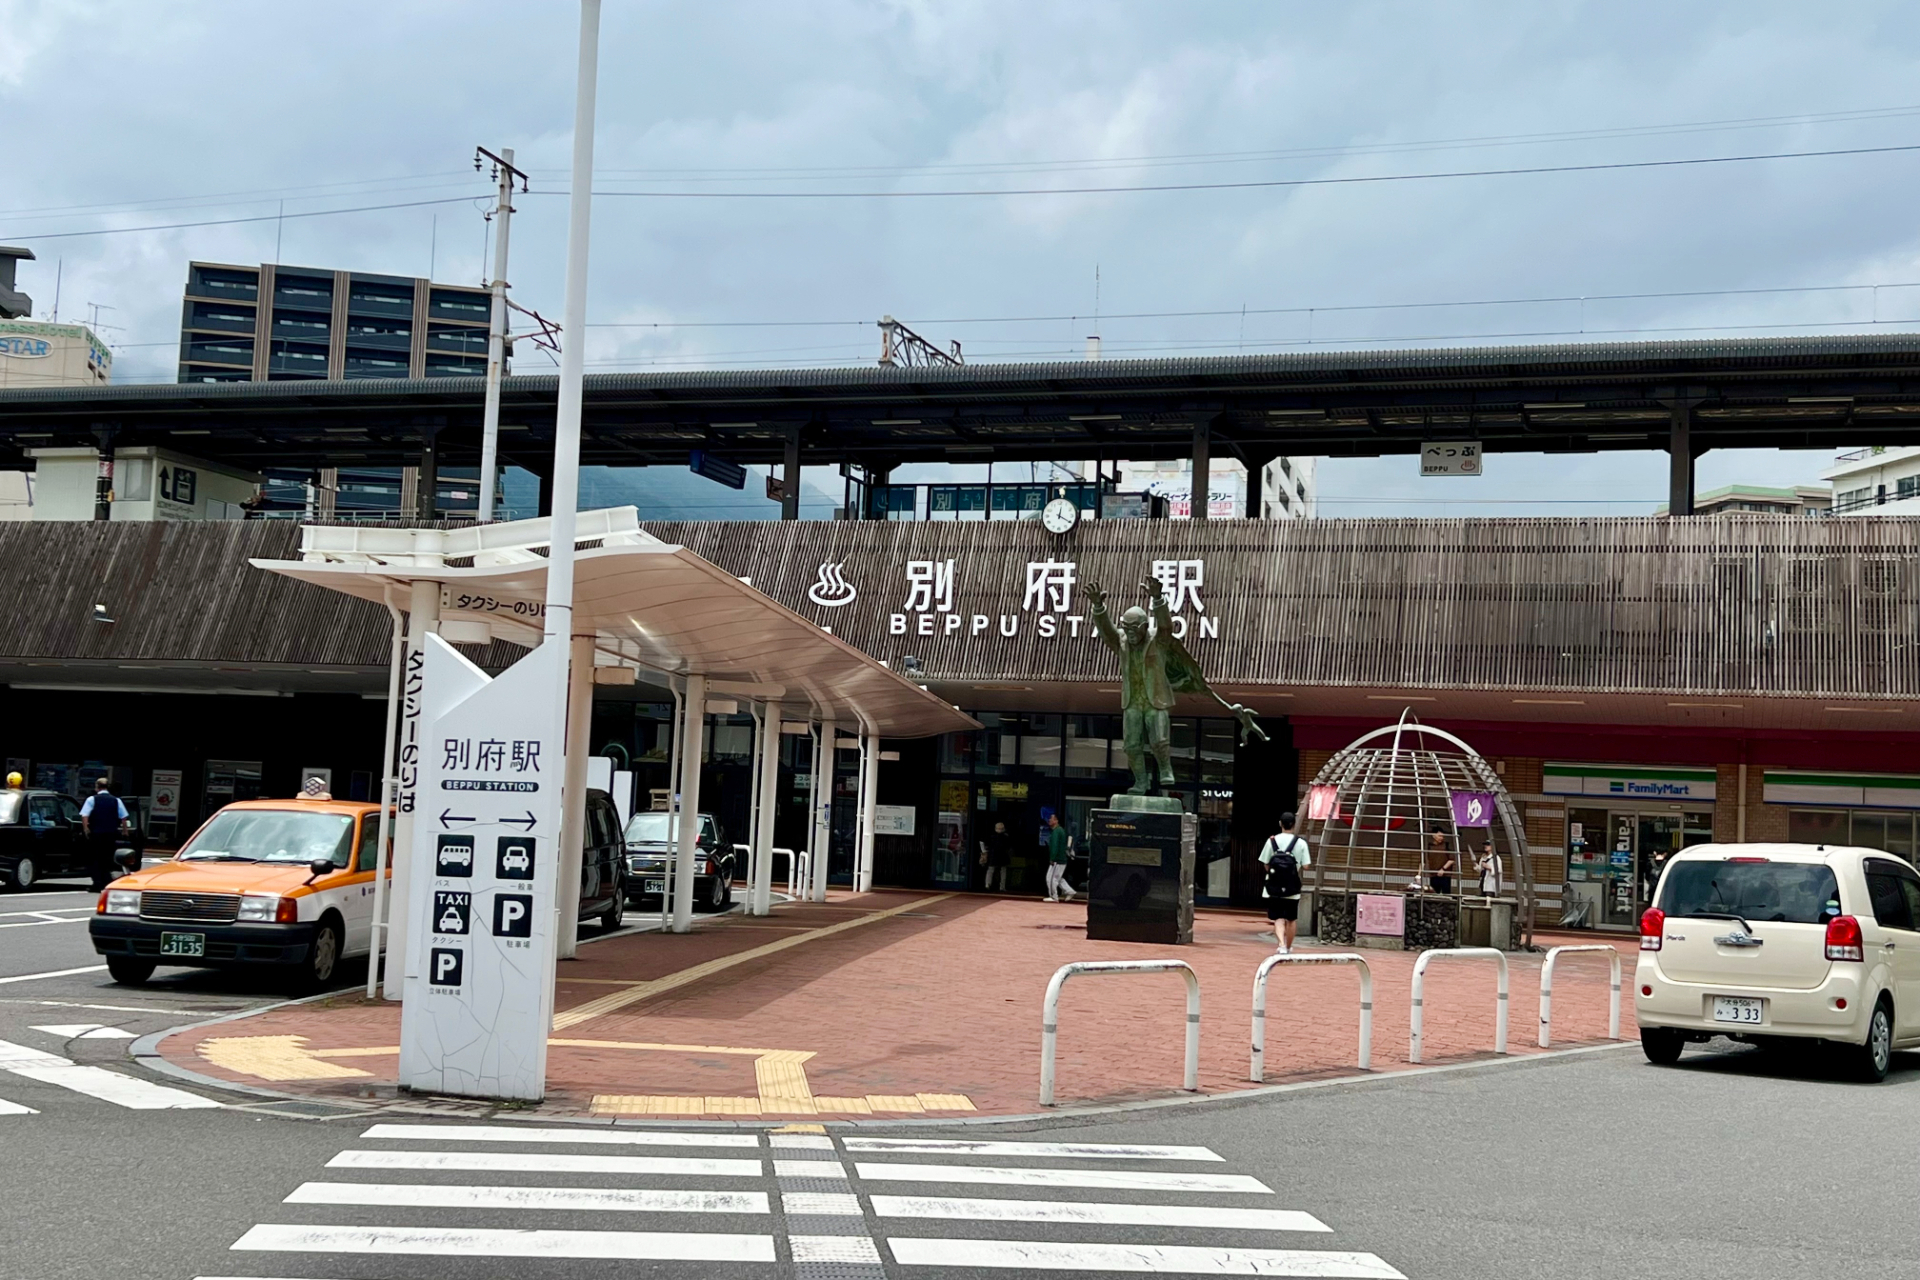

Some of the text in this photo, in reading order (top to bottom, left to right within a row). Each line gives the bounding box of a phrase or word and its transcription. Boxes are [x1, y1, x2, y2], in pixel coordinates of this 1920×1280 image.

[1427, 446, 1475, 457] べっぷ
[904, 558, 1205, 613] 別府駅
[889, 614, 1218, 639] BEPPU STION
[441, 738, 541, 773] 別府駅
[446, 781, 534, 792] BEPPU STATION
[1628, 783, 1689, 795] FamilyMart
[1466, 798, 1482, 822] ゆ
[510, 883, 534, 891] 一般車
[437, 893, 469, 906] TAXI
[501, 900, 525, 932] P
[432, 936, 462, 944] タクシー
[506, 940, 530, 949] 駐車場
[170, 941, 202, 954] 31-35
[437, 953, 457, 981] P
[429, 987, 461, 996] 立体駐車場
